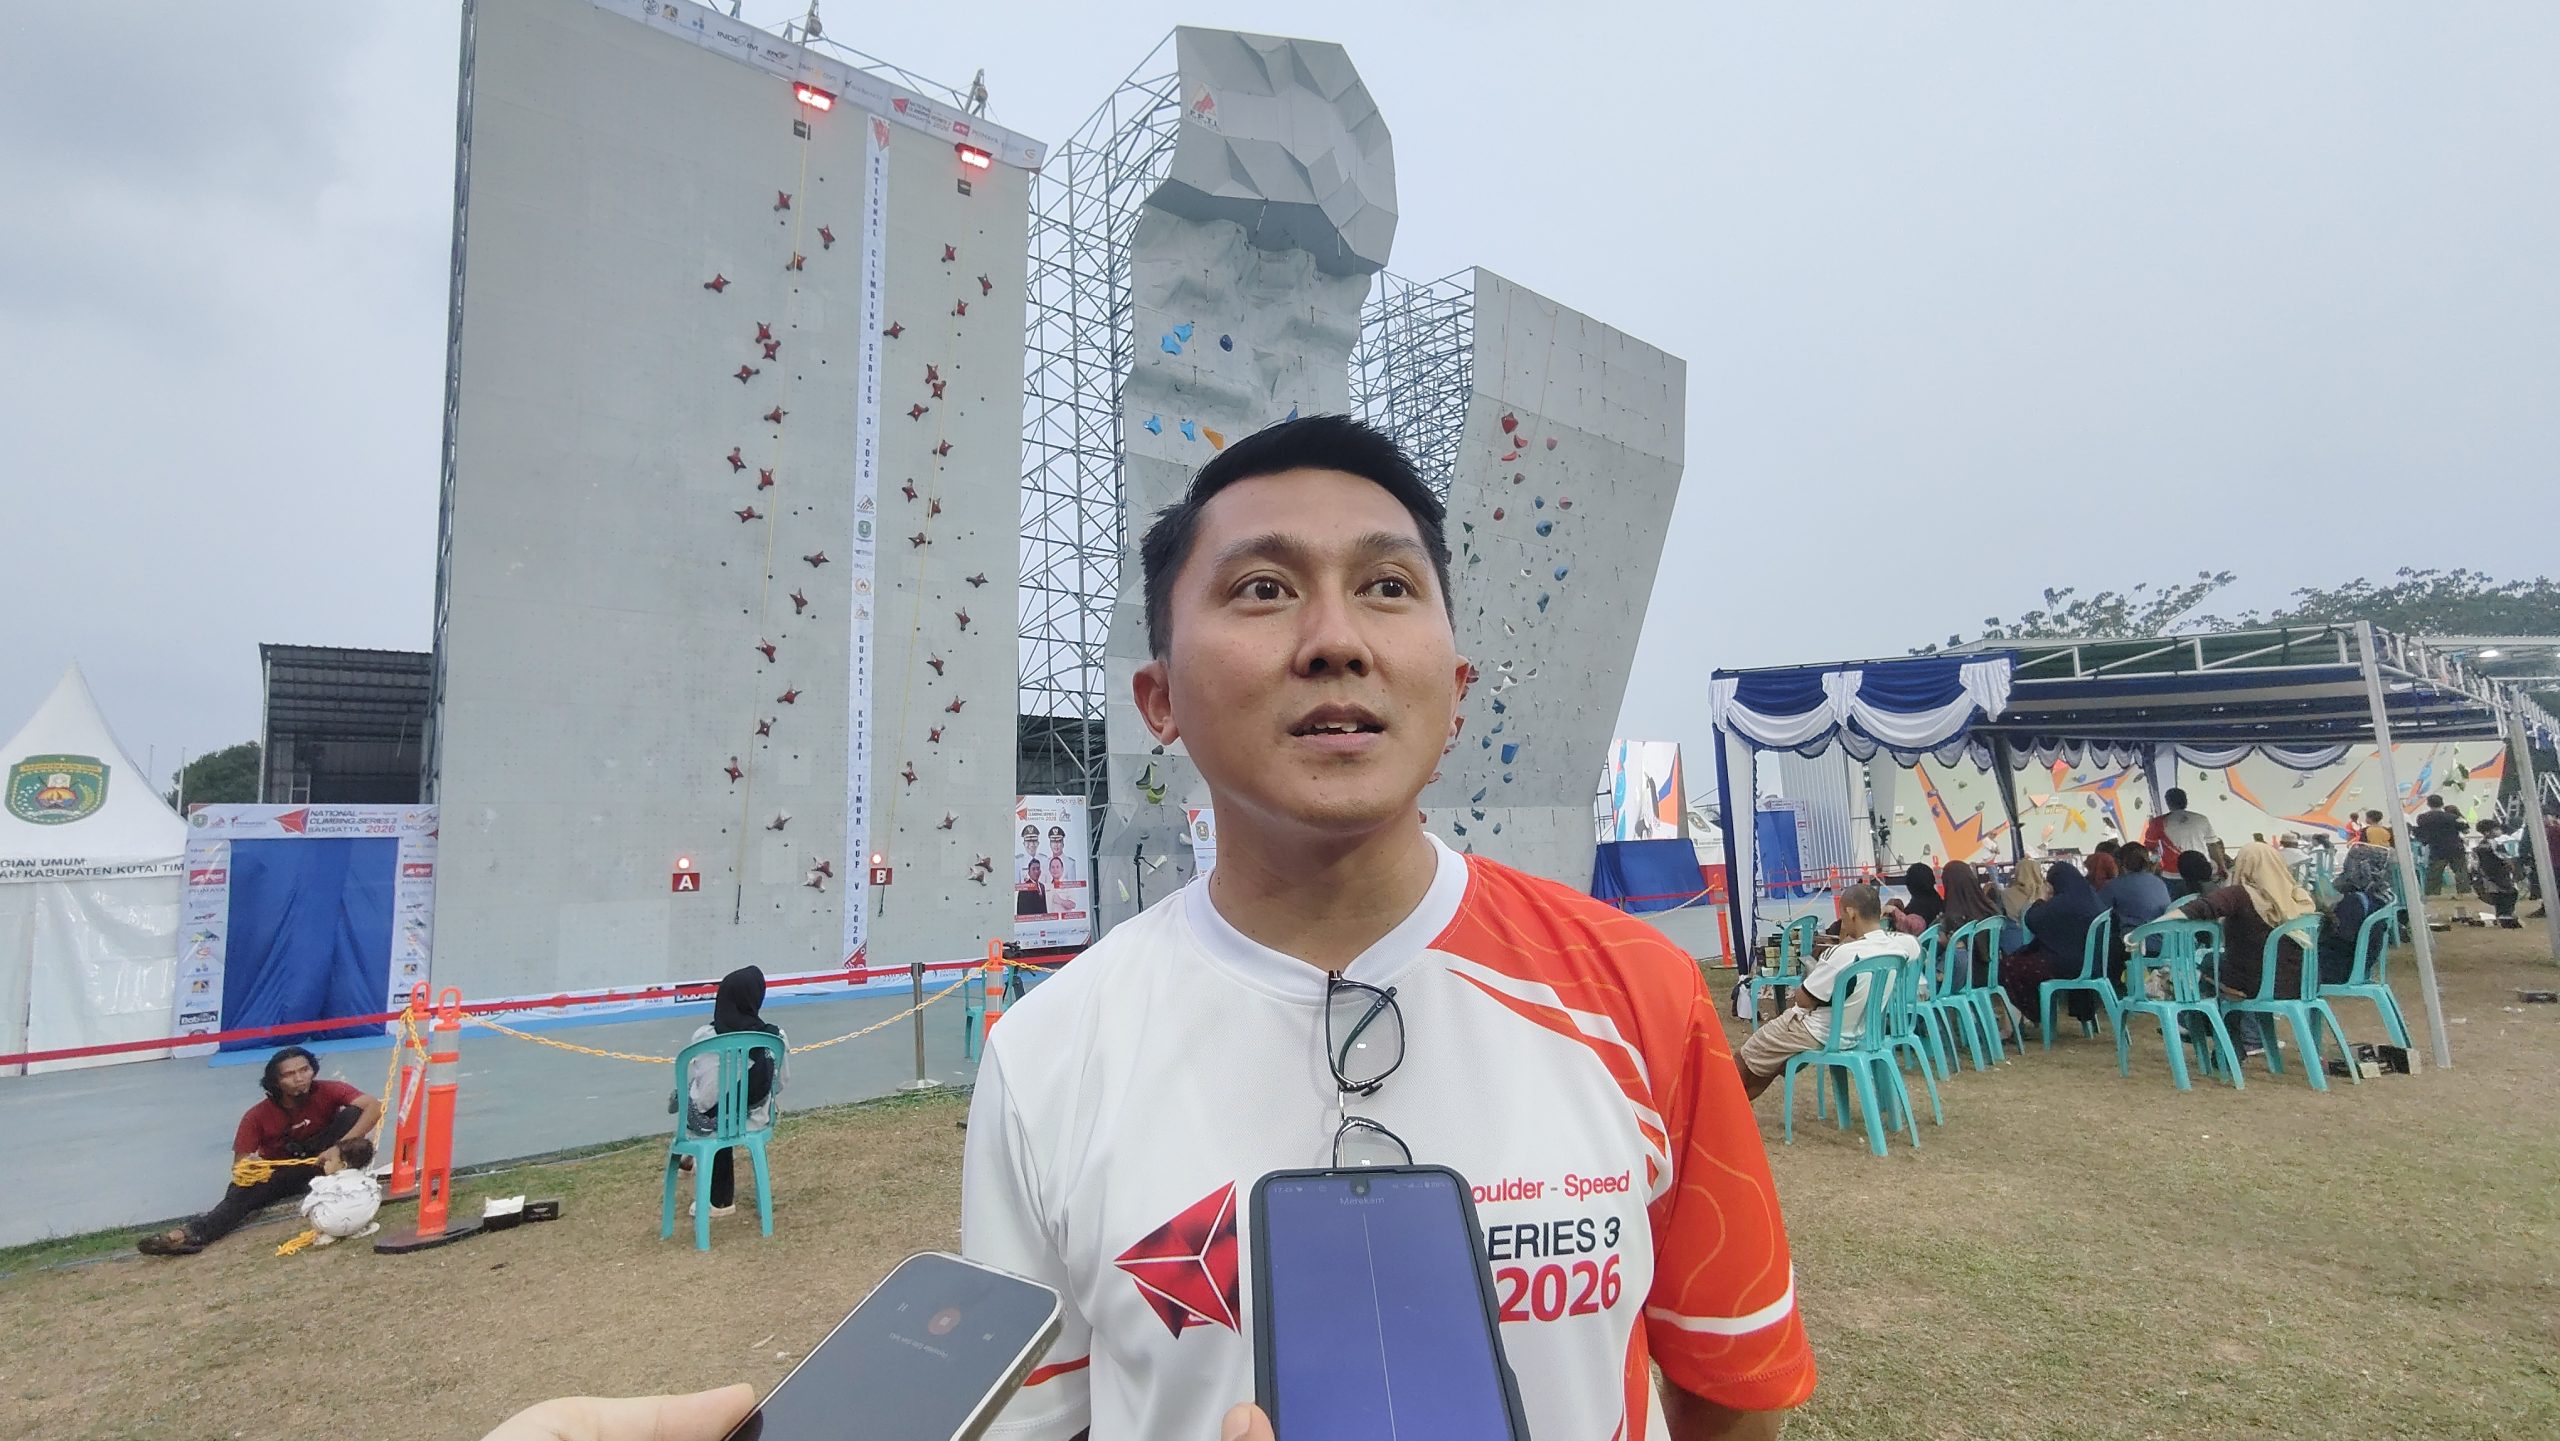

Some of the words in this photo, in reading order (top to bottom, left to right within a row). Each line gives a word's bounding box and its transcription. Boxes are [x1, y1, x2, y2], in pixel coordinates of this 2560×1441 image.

[855, 774, 863, 825] TIMUR
[365, 825, 396, 833] 2026
[41, 858, 85, 867] UMUM
[24, 867, 112, 878] KABUPATEN
[117, 864, 158, 874] KUTAI
[876, 869, 887, 884] B
[678, 874, 694, 890] A
[1472, 1177, 1545, 1204] oulder
[1564, 1170, 1630, 1202] Speed
[1483, 1218, 1597, 1261] ERIES
[1603, 1216, 1621, 1248] 3
[1496, 1253, 1622, 1324] 2026
